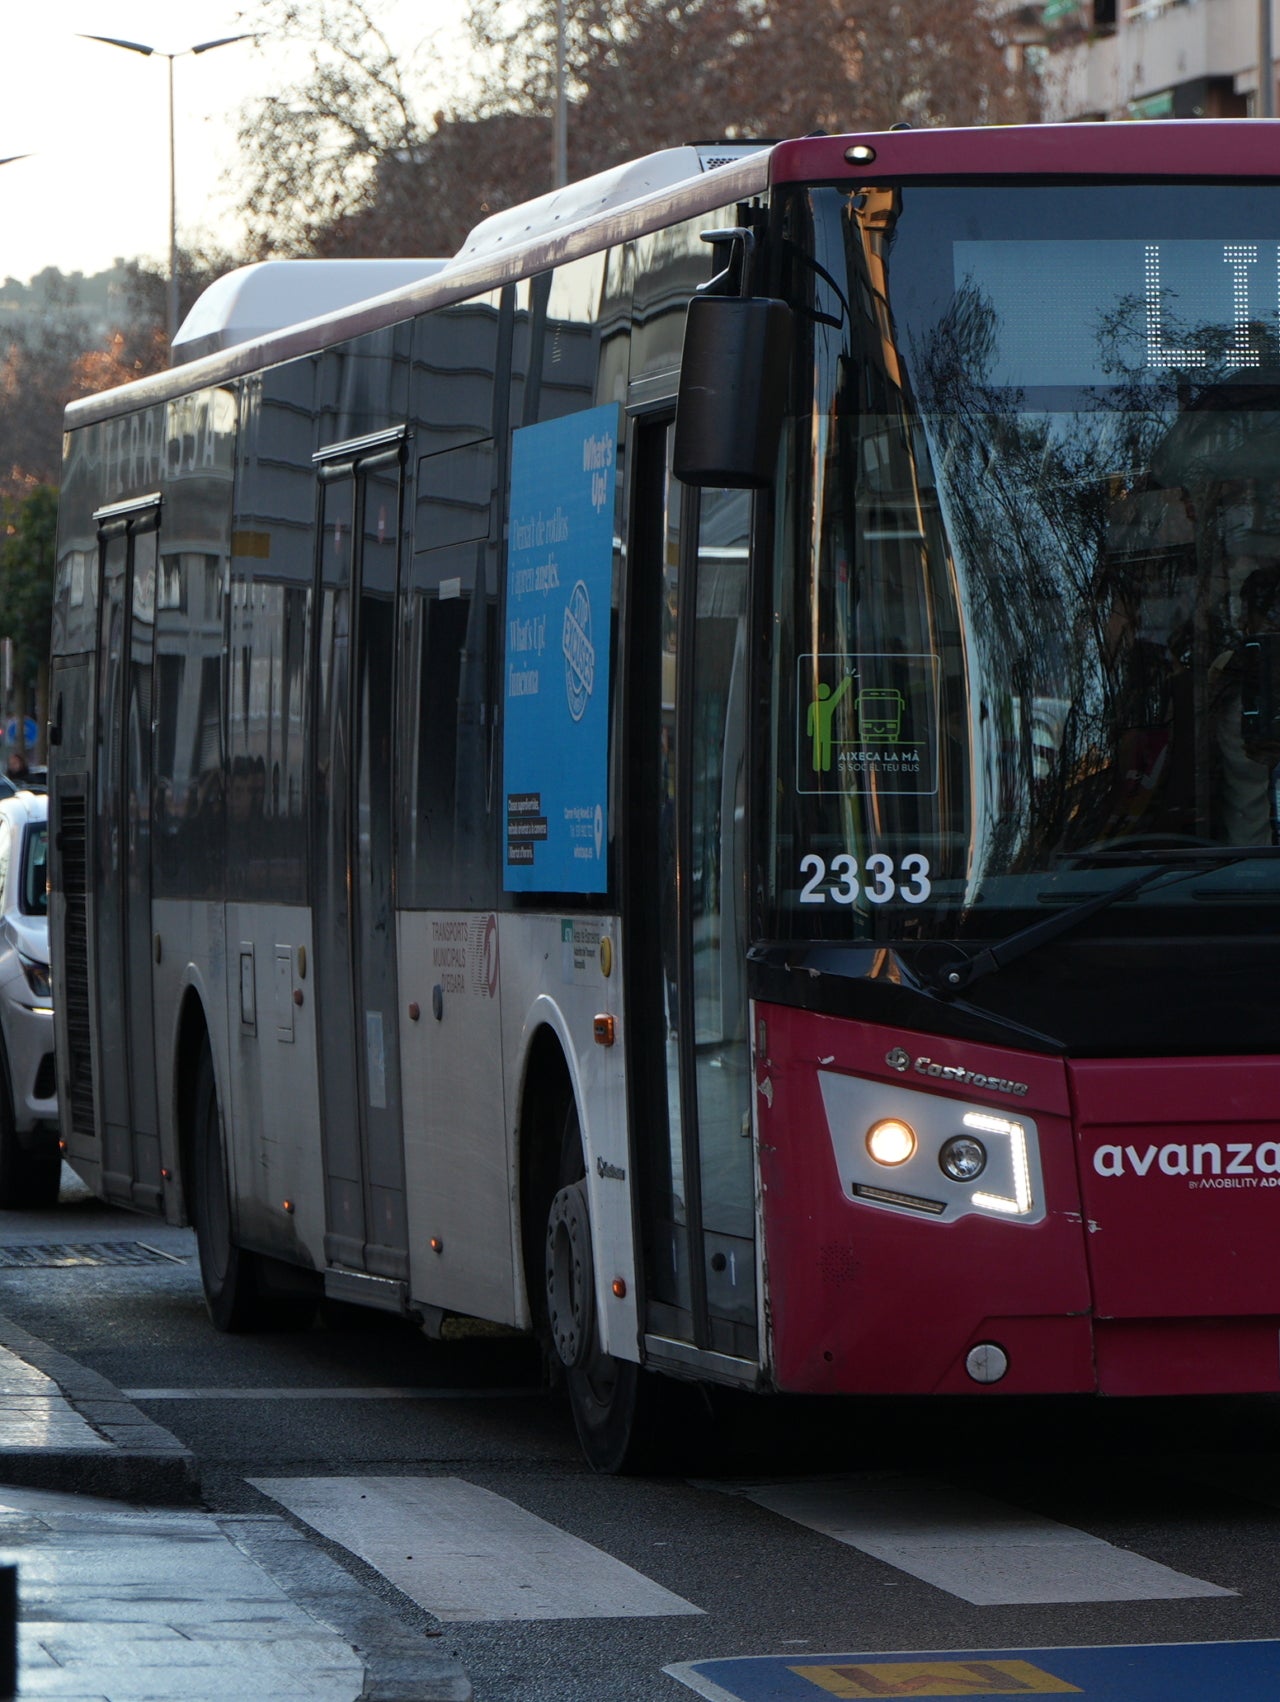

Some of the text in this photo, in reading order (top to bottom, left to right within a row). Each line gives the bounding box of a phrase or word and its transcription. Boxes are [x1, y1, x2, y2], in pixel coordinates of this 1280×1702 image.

[583, 431, 613, 473] What's
[591, 469, 608, 514] Up!
[839, 750, 920, 761] AIXECA LA MÀ
[869, 763, 880, 772] EL
[882, 763, 899, 772] TEU
[901, 763, 920, 772] BUS
[800, 853, 932, 904] 2333
[432, 922, 468, 942] TRANSPORTS
[433, 947, 466, 968] MUNICIPALS
[441, 973, 466, 993] D'EGARA
[914, 1056, 1029, 1096] Castrosua
[1188, 1180, 1198, 1190] BY
[1199, 1177, 1259, 1189] MOBILITY
